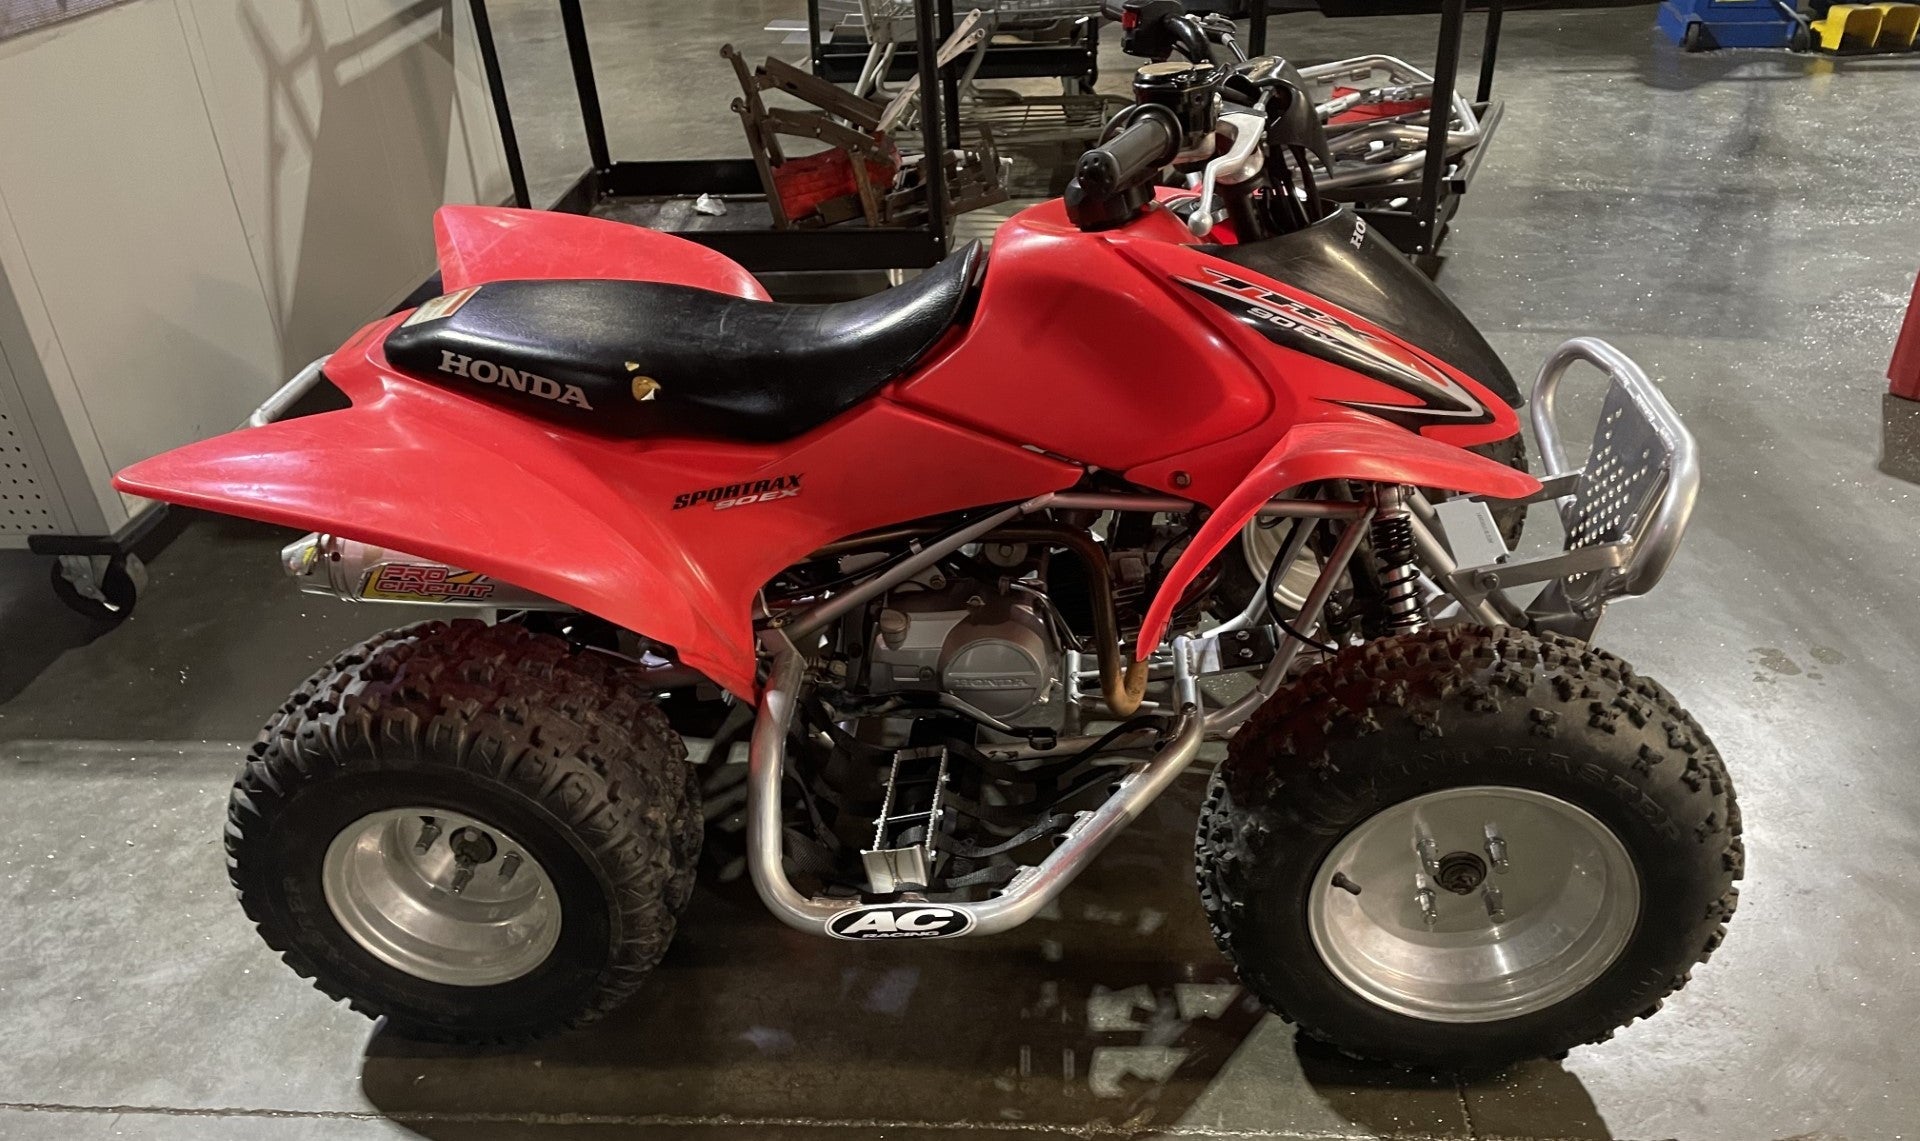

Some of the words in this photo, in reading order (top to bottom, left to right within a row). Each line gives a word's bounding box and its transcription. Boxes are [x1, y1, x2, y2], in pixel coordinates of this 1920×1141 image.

[438, 350, 593, 411] HONDA
[672, 472, 805, 510] SPORTRAX
[713, 488, 802, 511] 90EX
[381, 565, 449, 583] PRO
[376, 580, 494, 599] CIRCUIT
[840, 908, 954, 934] AC
